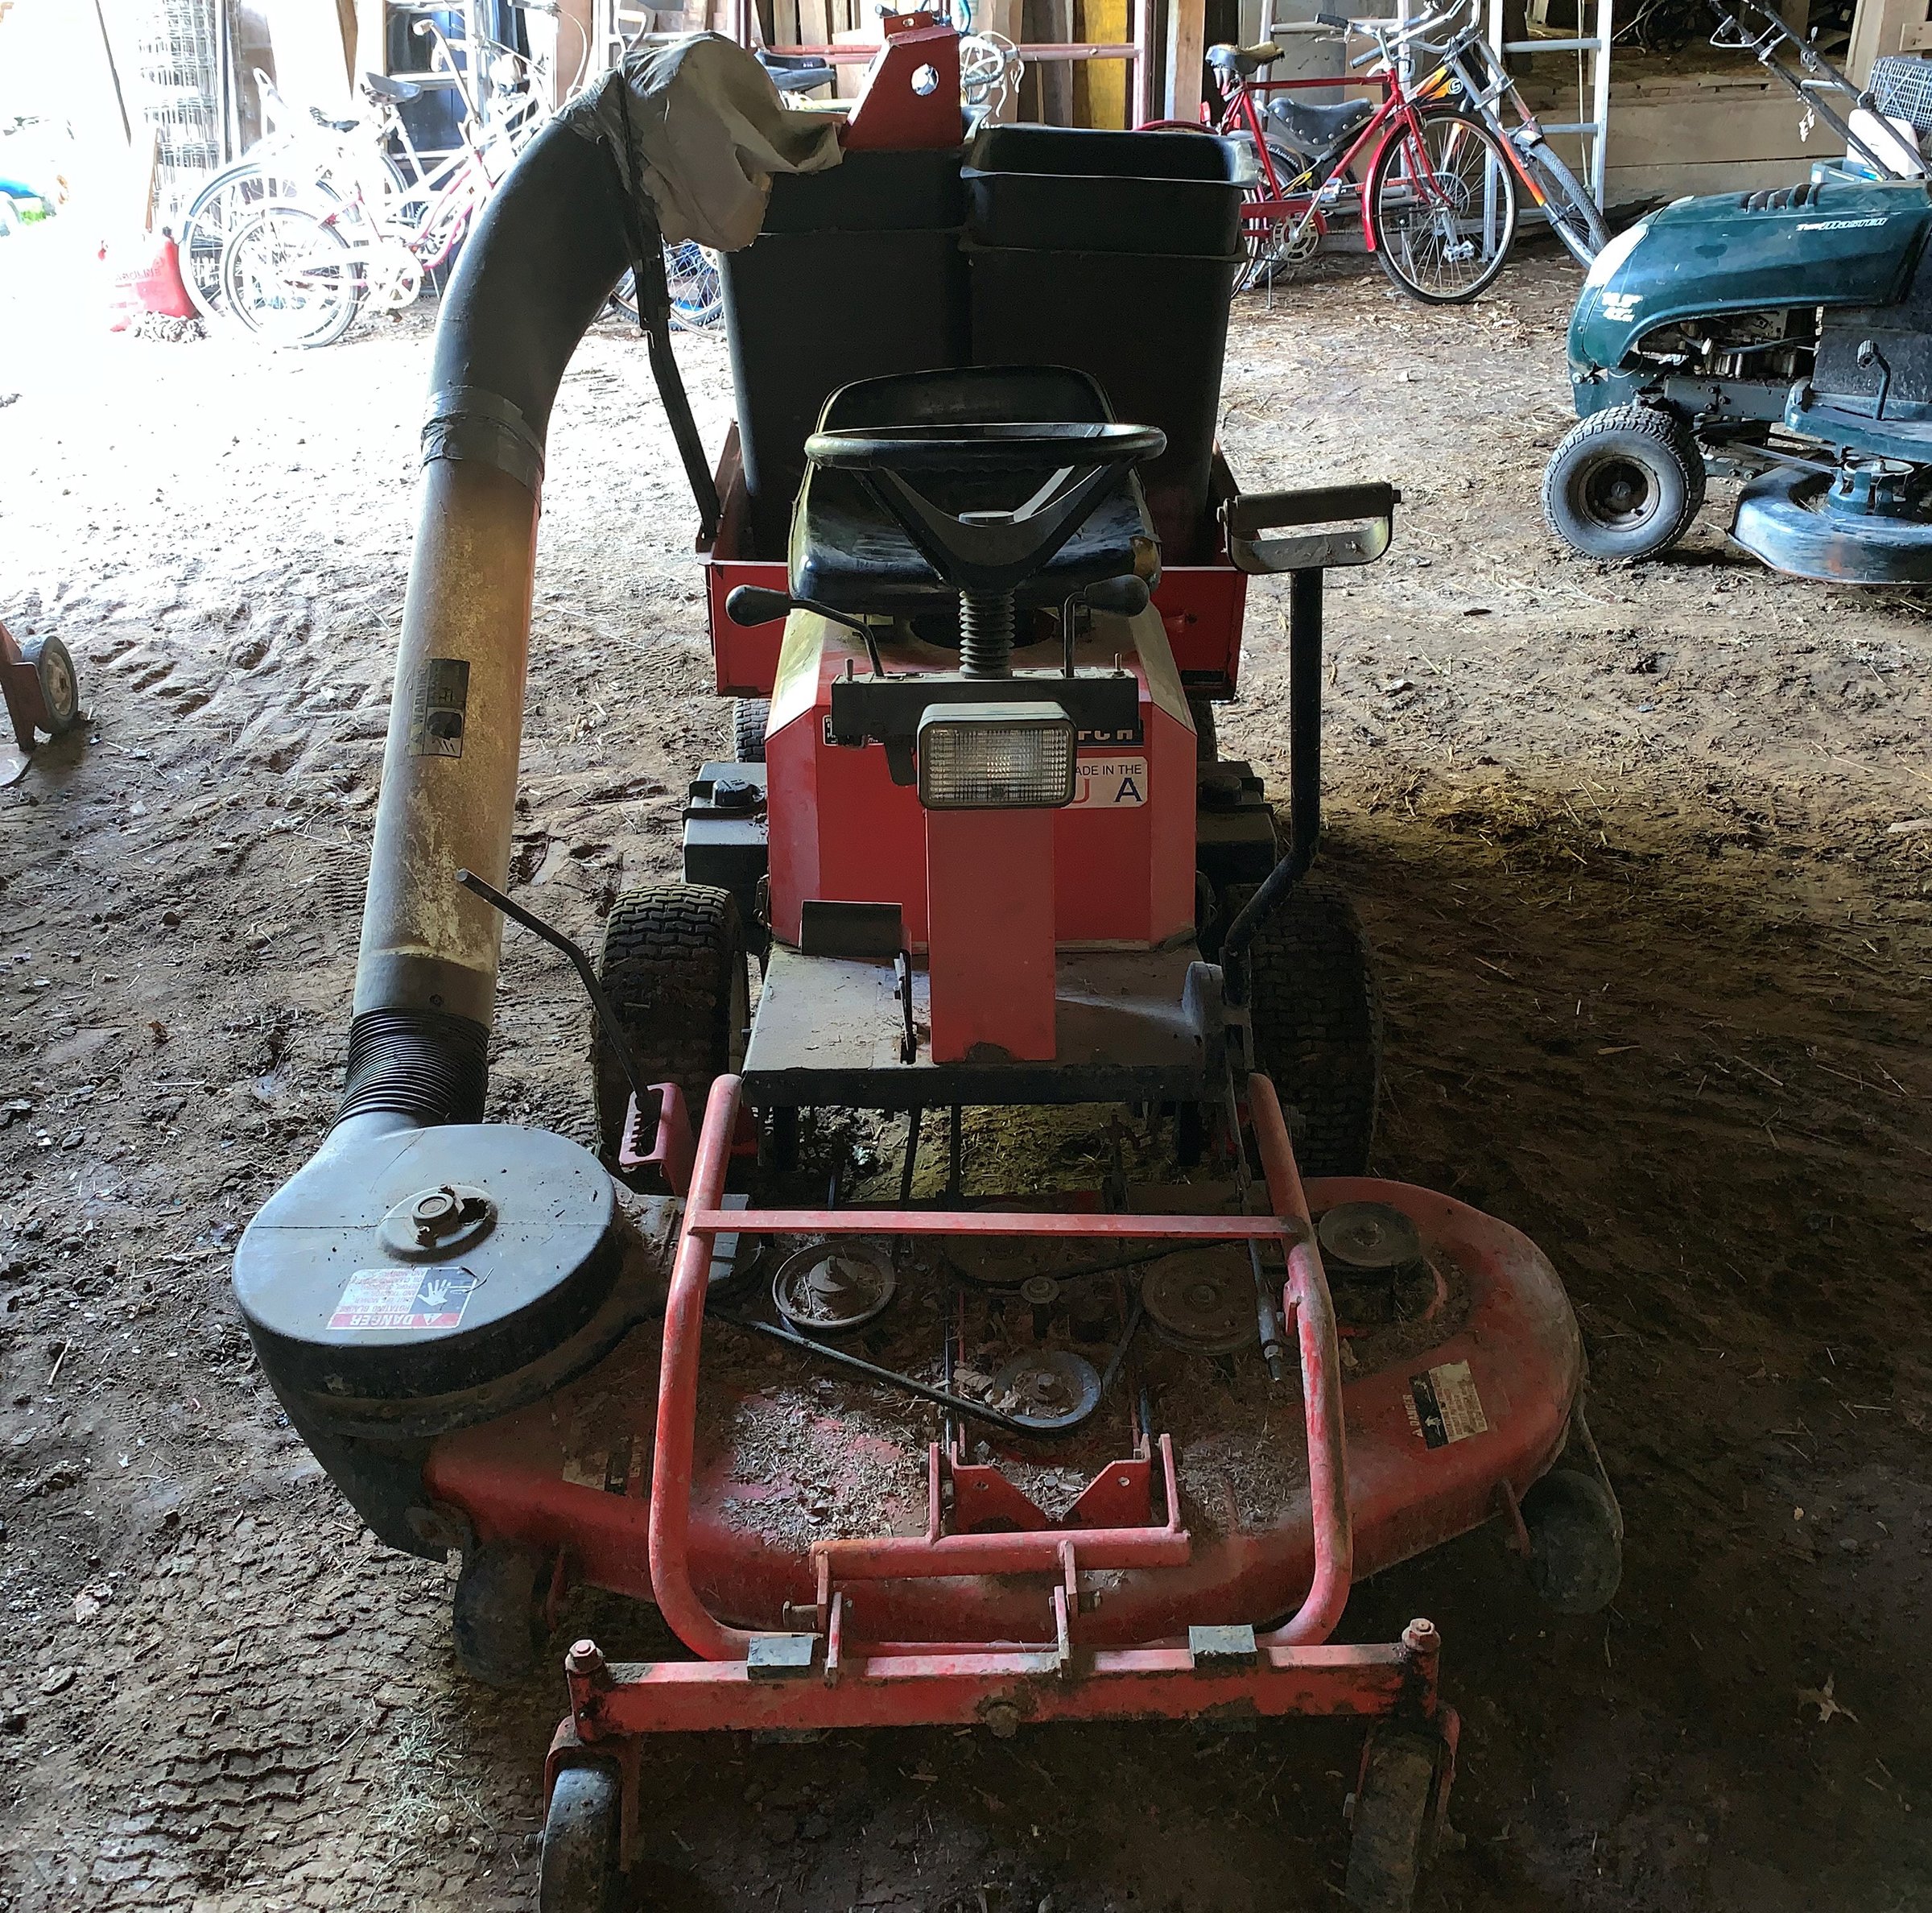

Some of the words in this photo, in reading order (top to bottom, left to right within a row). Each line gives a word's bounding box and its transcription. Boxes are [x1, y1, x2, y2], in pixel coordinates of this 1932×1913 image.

[1075, 765, 1099, 775] ADE
[1102, 765, 1114, 775] IN
[1118, 764, 1142, 775] THE
[350, 1314, 415, 1326] DANGER
[1403, 1394, 1420, 1426] DANGER
